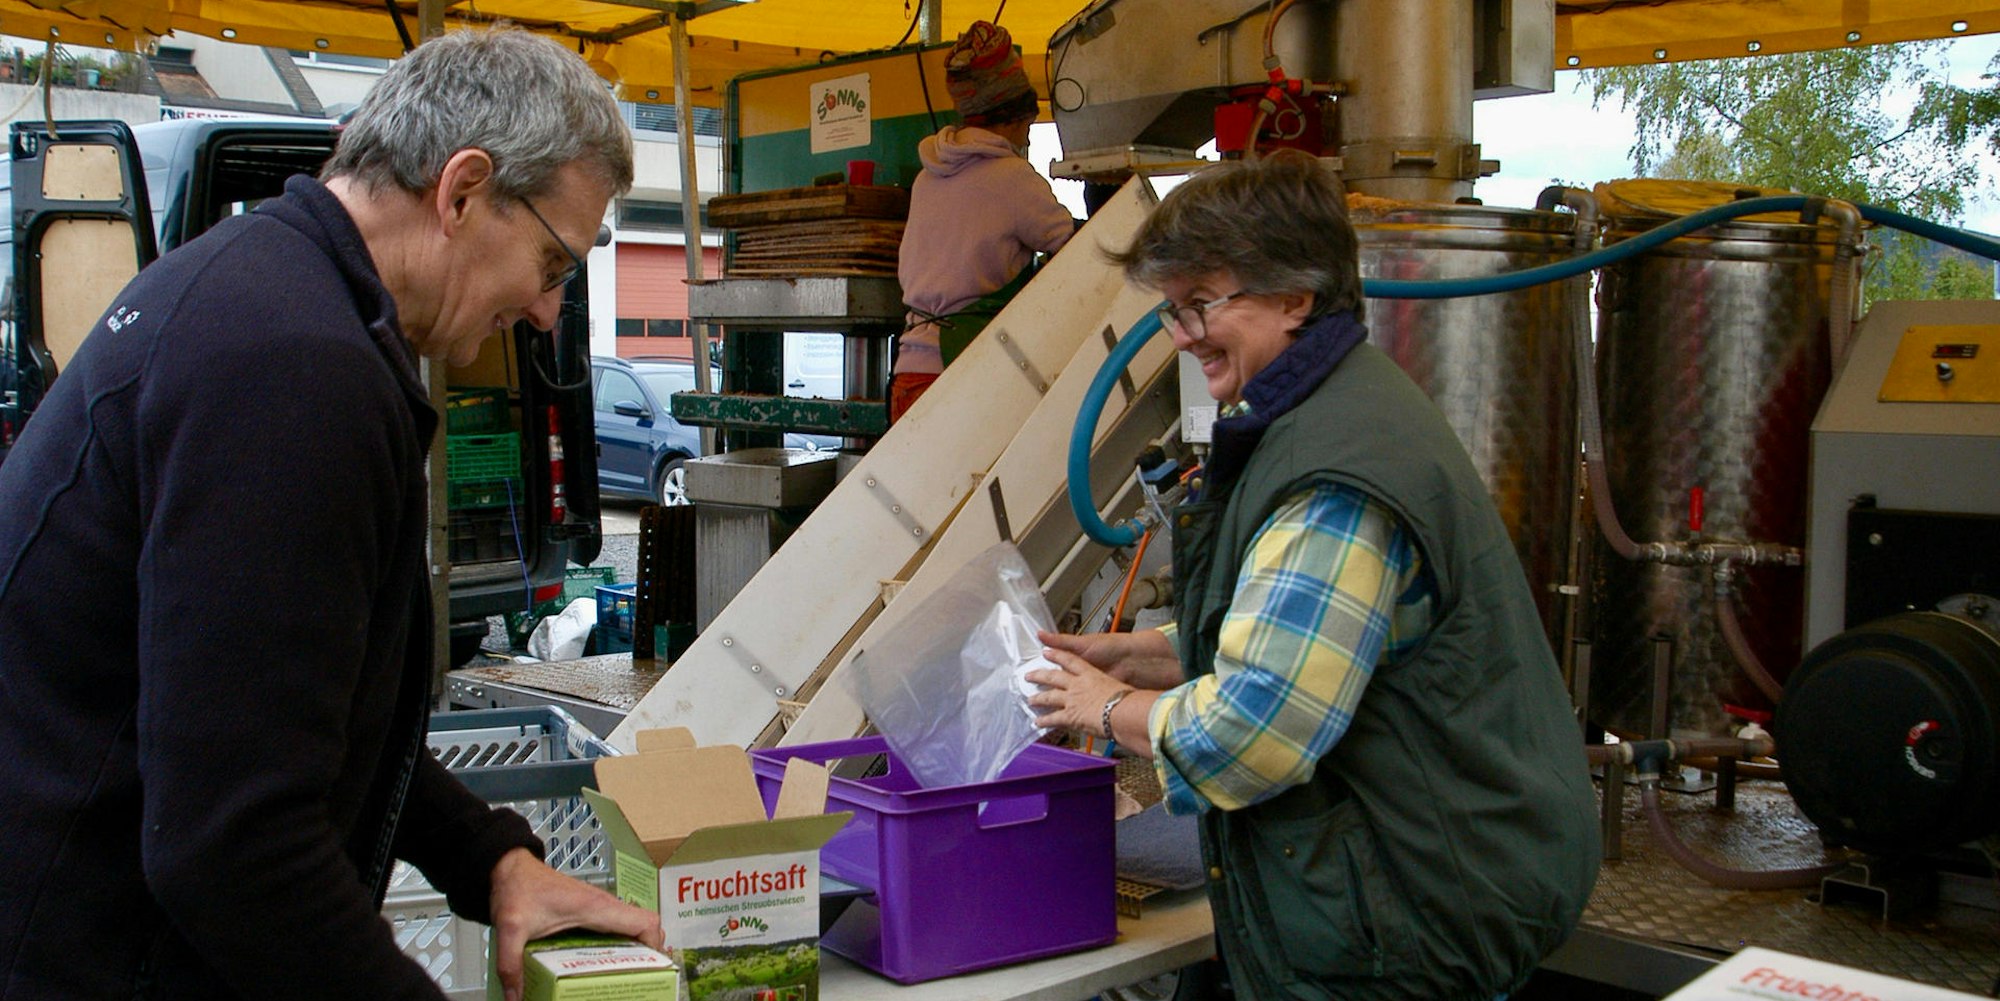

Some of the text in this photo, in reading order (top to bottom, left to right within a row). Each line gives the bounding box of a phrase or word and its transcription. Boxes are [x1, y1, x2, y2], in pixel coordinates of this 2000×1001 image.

[678, 864, 807, 903] Fruchtsaft
[678, 895, 806, 918] von heimischen Streuobstwiesen
[561, 955, 657, 969] Fruchtsaft
